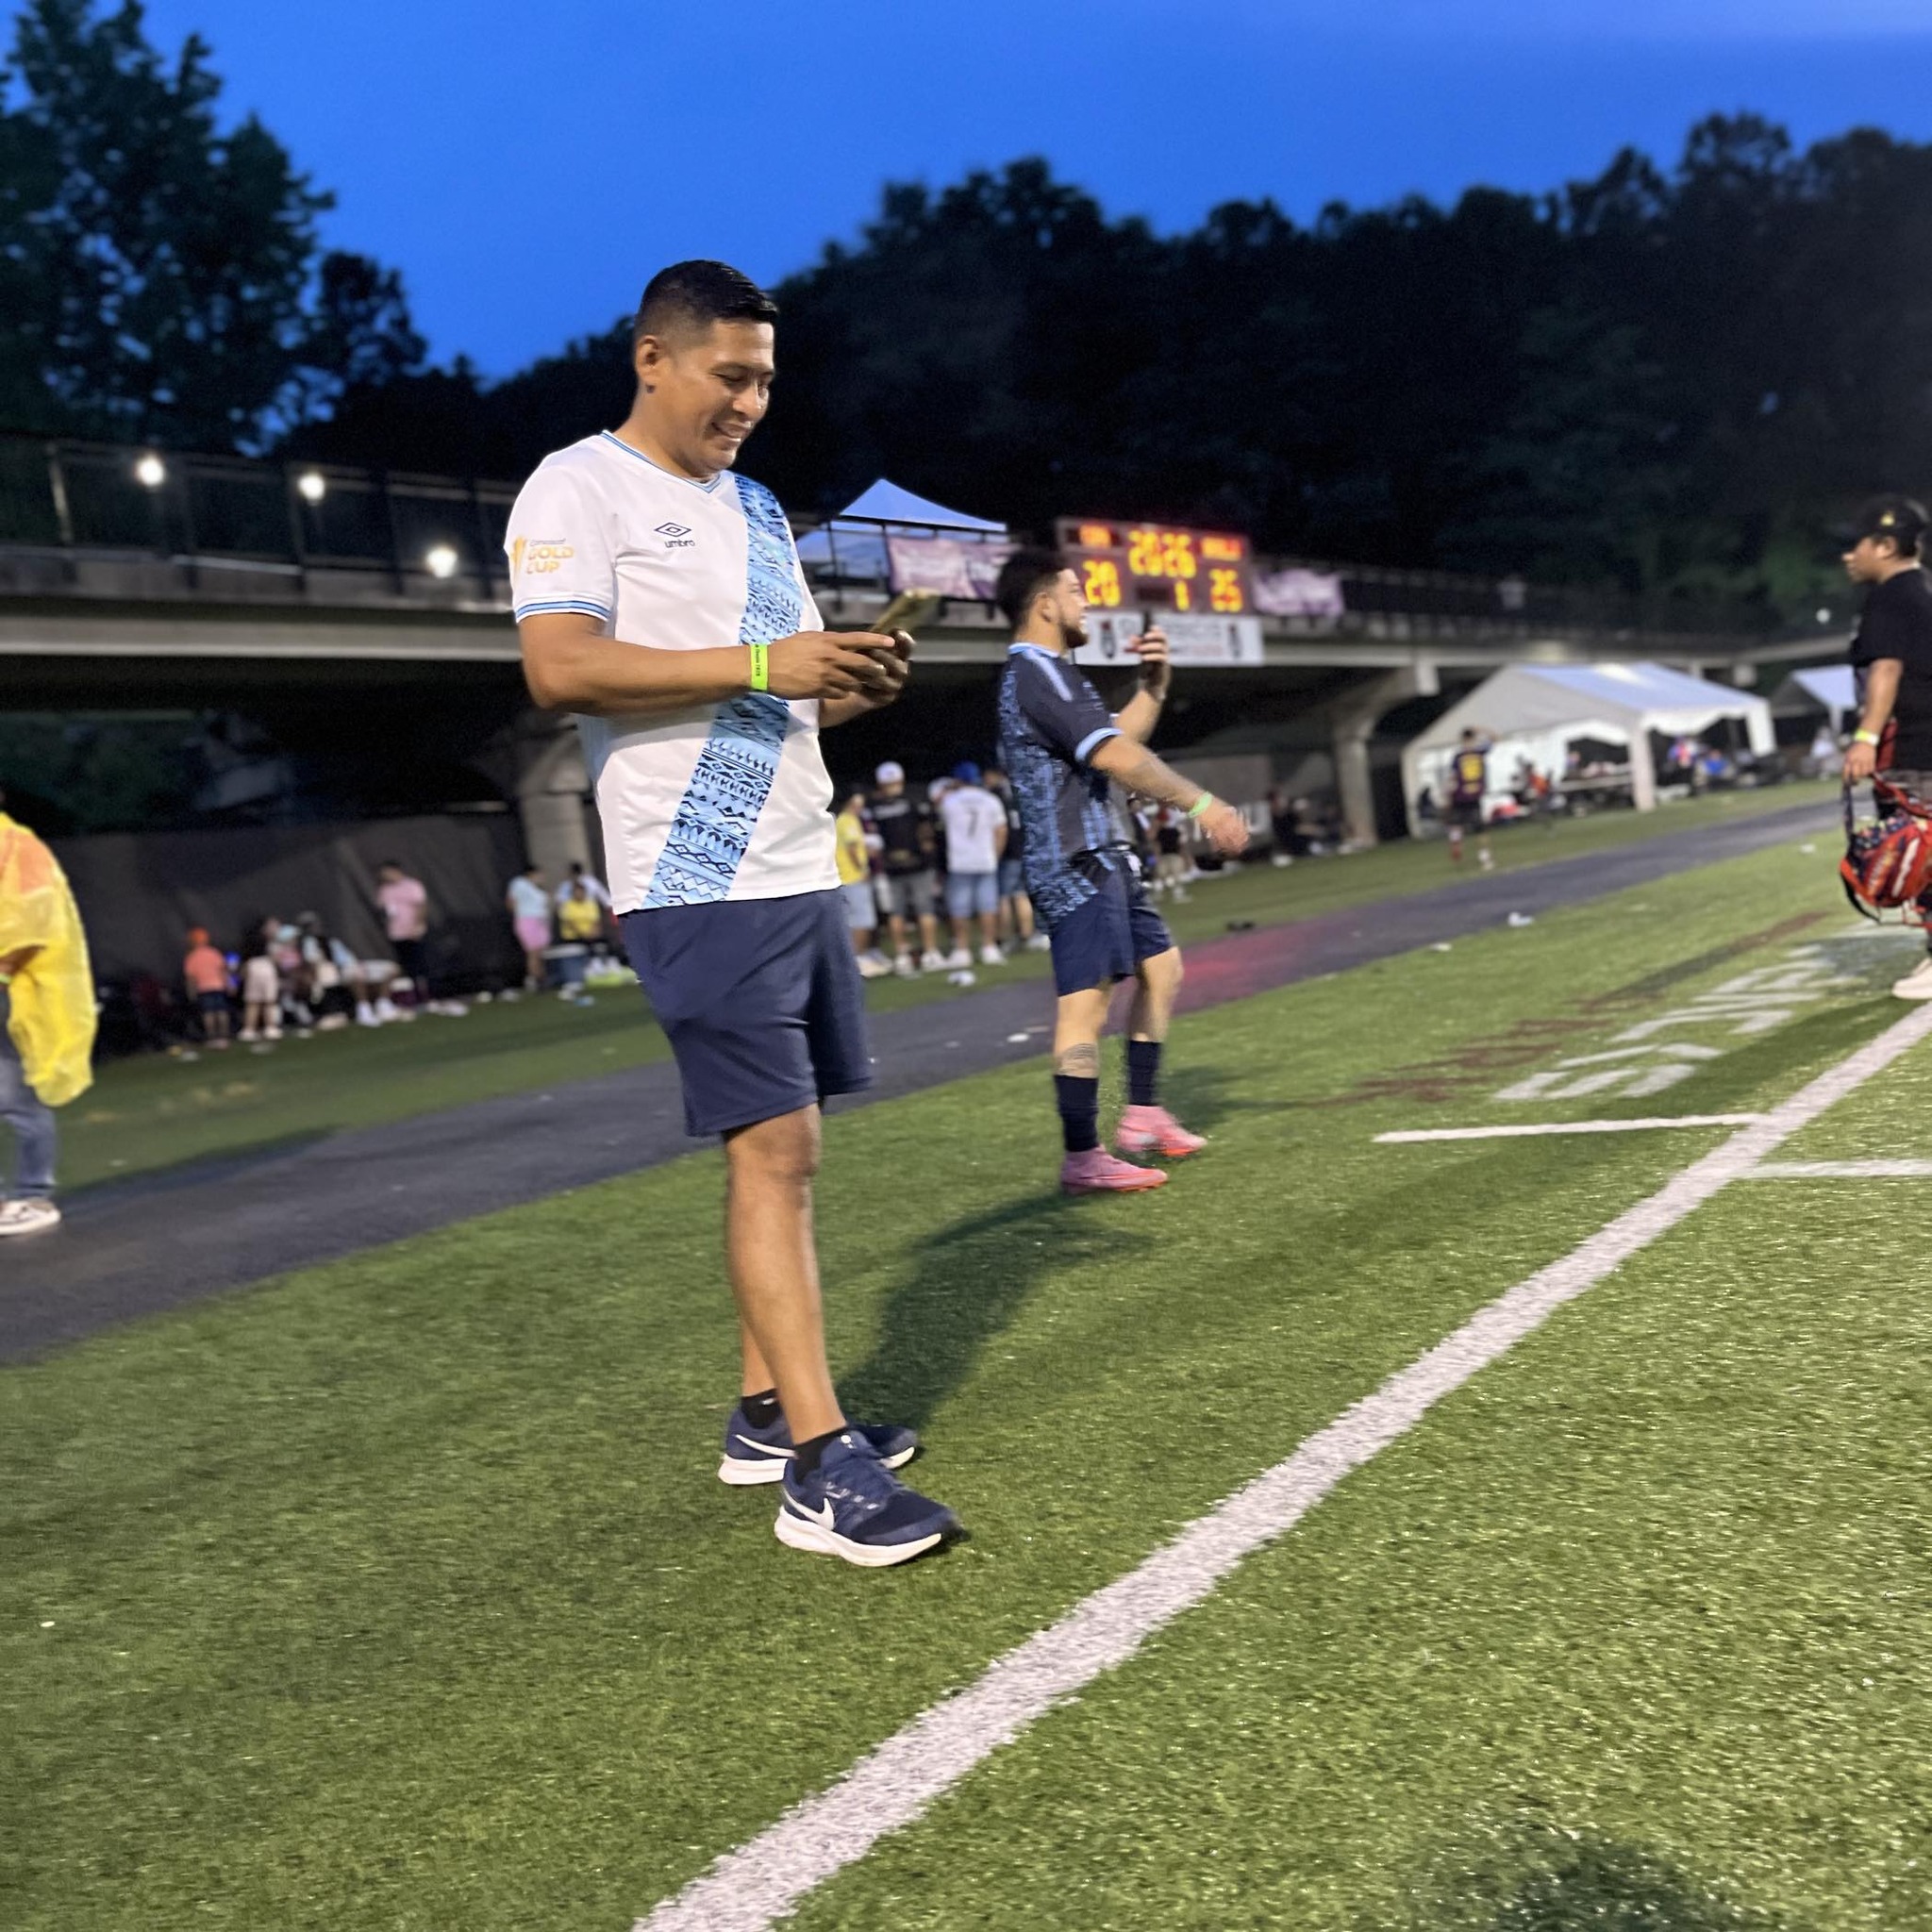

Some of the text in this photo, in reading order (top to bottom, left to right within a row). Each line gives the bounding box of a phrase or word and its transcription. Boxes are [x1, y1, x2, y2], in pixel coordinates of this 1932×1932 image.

[664, 539, 696, 548] umbro
[528, 546, 575, 560] GOLD
[526, 560, 560, 575] CUP
